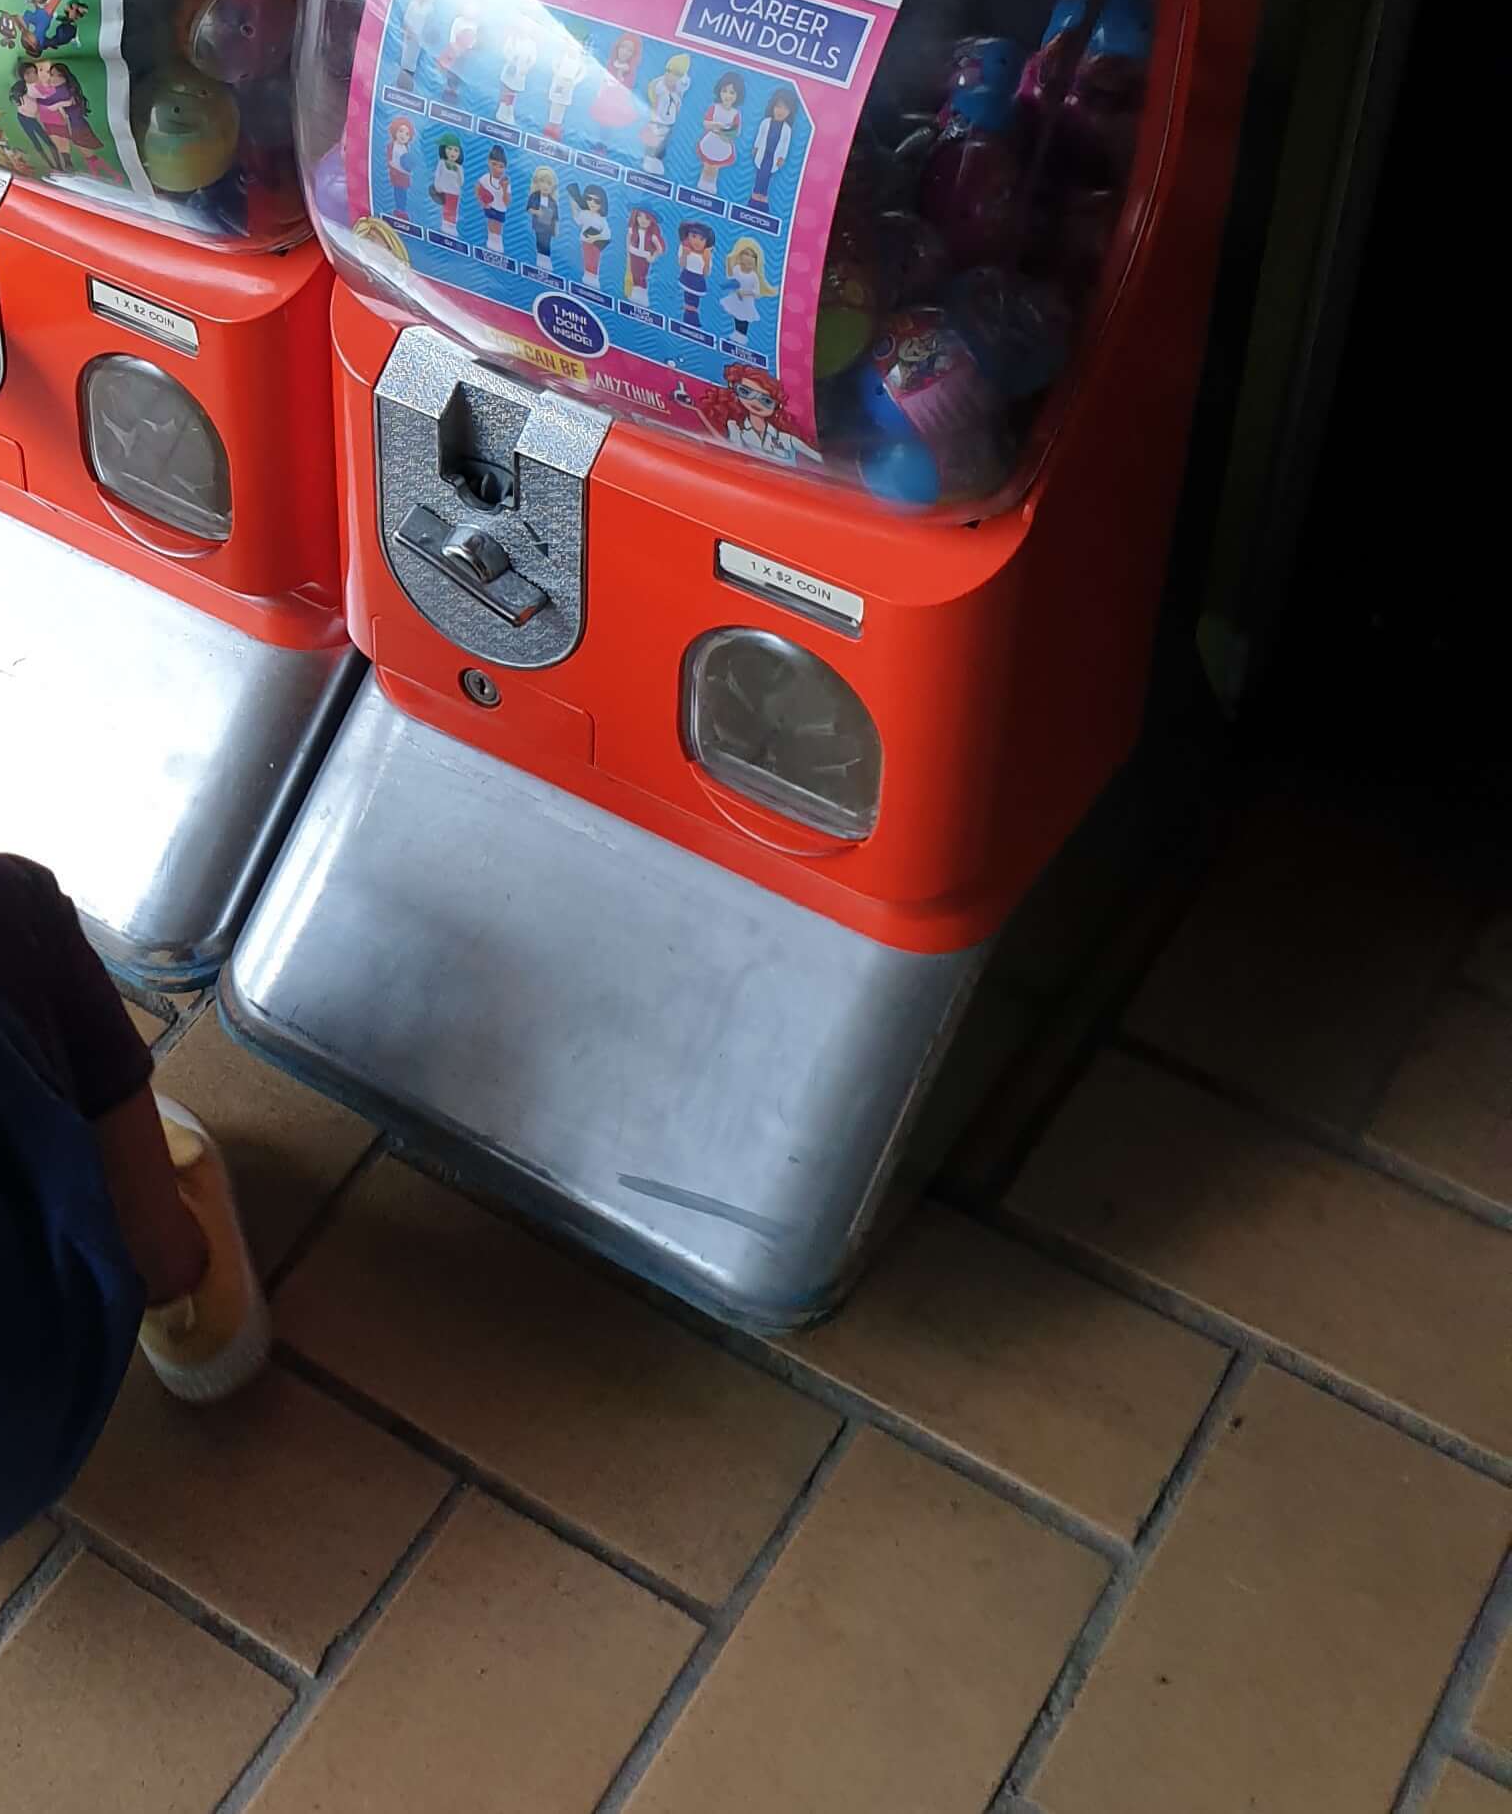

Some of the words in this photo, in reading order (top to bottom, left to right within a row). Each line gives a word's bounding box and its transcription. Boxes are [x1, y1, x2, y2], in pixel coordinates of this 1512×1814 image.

[697, 7, 756, 44] MINI
[756, 25, 842, 71] DOLLS
[738, 210, 772, 228] DOCTOR
[133, 303, 146, 317] $2
[148, 310, 176, 330] COIN
[552, 303, 560, 315] 1
[562, 308, 588, 327] MINI
[555, 316, 588, 337] DOLL
[553, 326, 594, 348] INSIDE!
[523, 345, 556, 371] CAN
[559, 358, 581, 379] BE
[594, 370, 666, 411] ANYTHING
[750, 560, 757, 571] 1
[762, 565, 772, 578] X
[775, 569, 793, 586] $2
[796, 578, 832, 602] COIN
